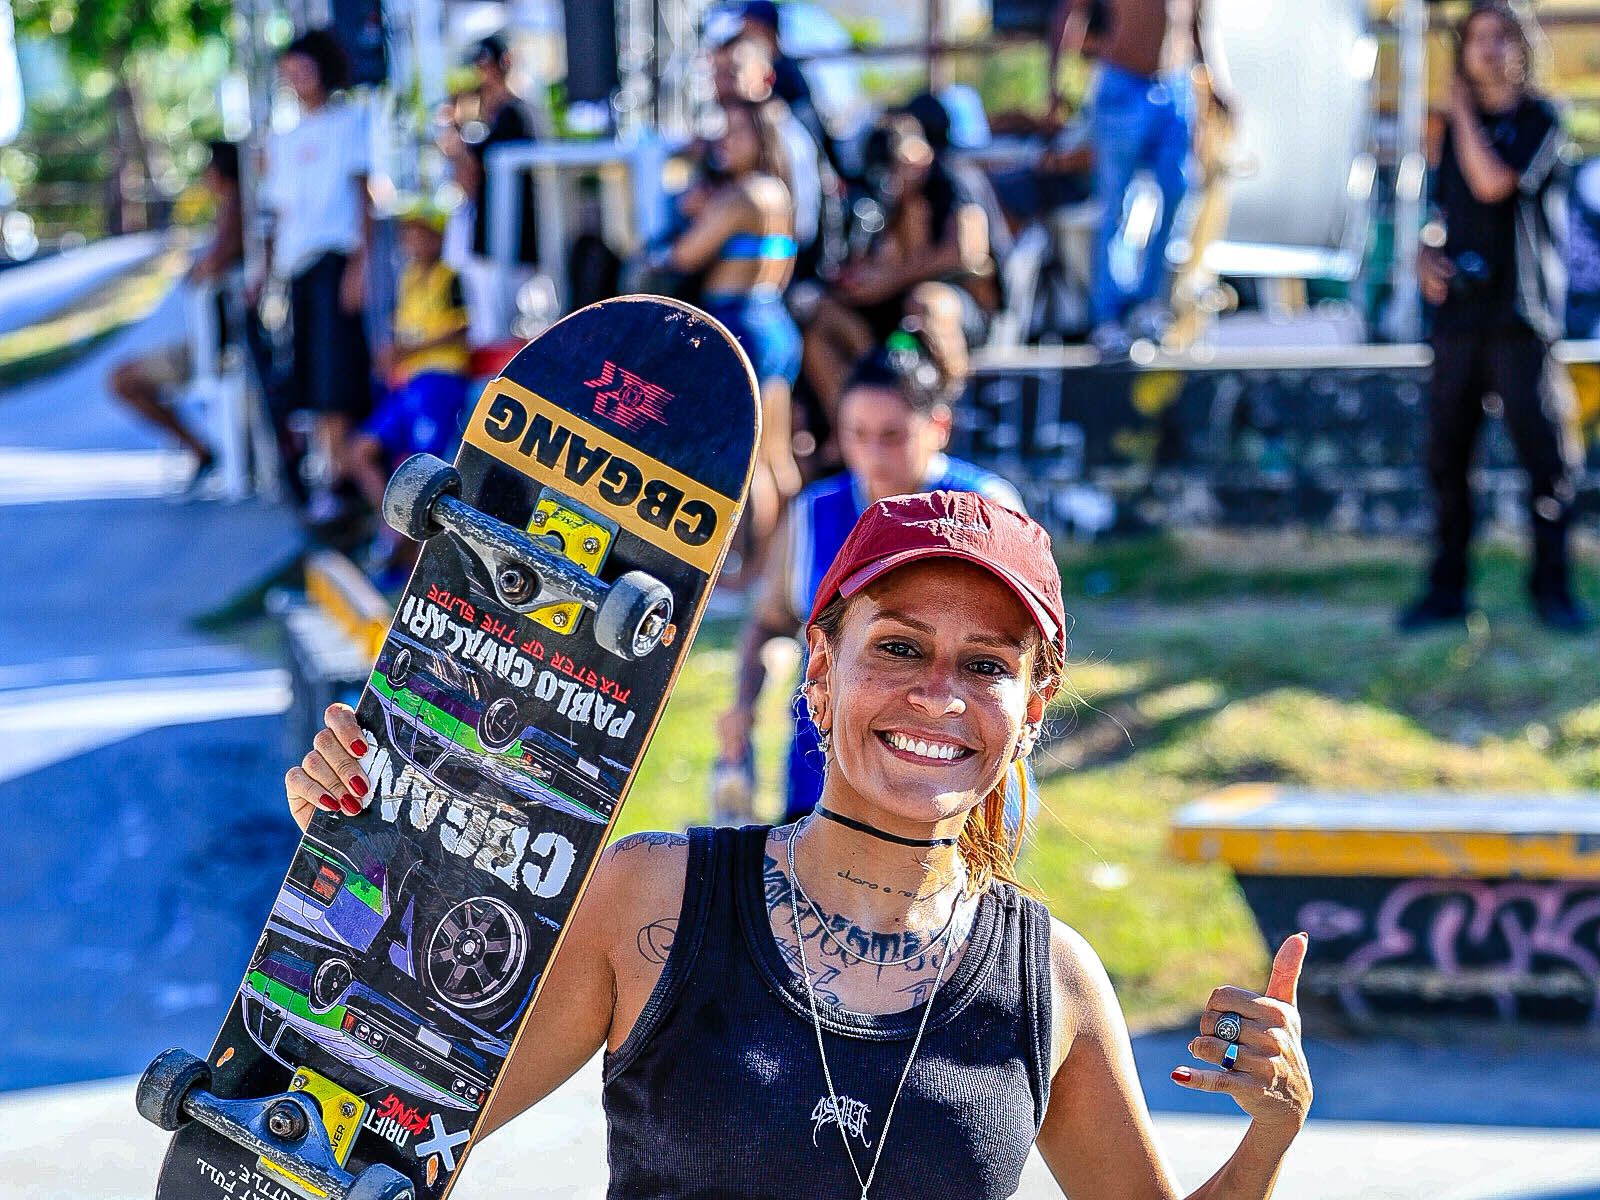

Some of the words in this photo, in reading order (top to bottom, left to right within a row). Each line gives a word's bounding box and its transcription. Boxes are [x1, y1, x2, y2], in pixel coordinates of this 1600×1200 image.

[485, 394, 717, 546] CBGANG
[427, 584, 474, 622] SLIDE
[402, 595, 535, 687] CAVALARI
[480, 614, 515, 644] THE
[520, 640, 544, 659] OF
[550, 652, 630, 703] MASTER
[535, 671, 635, 738] PABLO
[364, 1109, 410, 1148] DRIFT
[381, 1093, 431, 1137] KING
[197, 1158, 236, 1193] FULL
